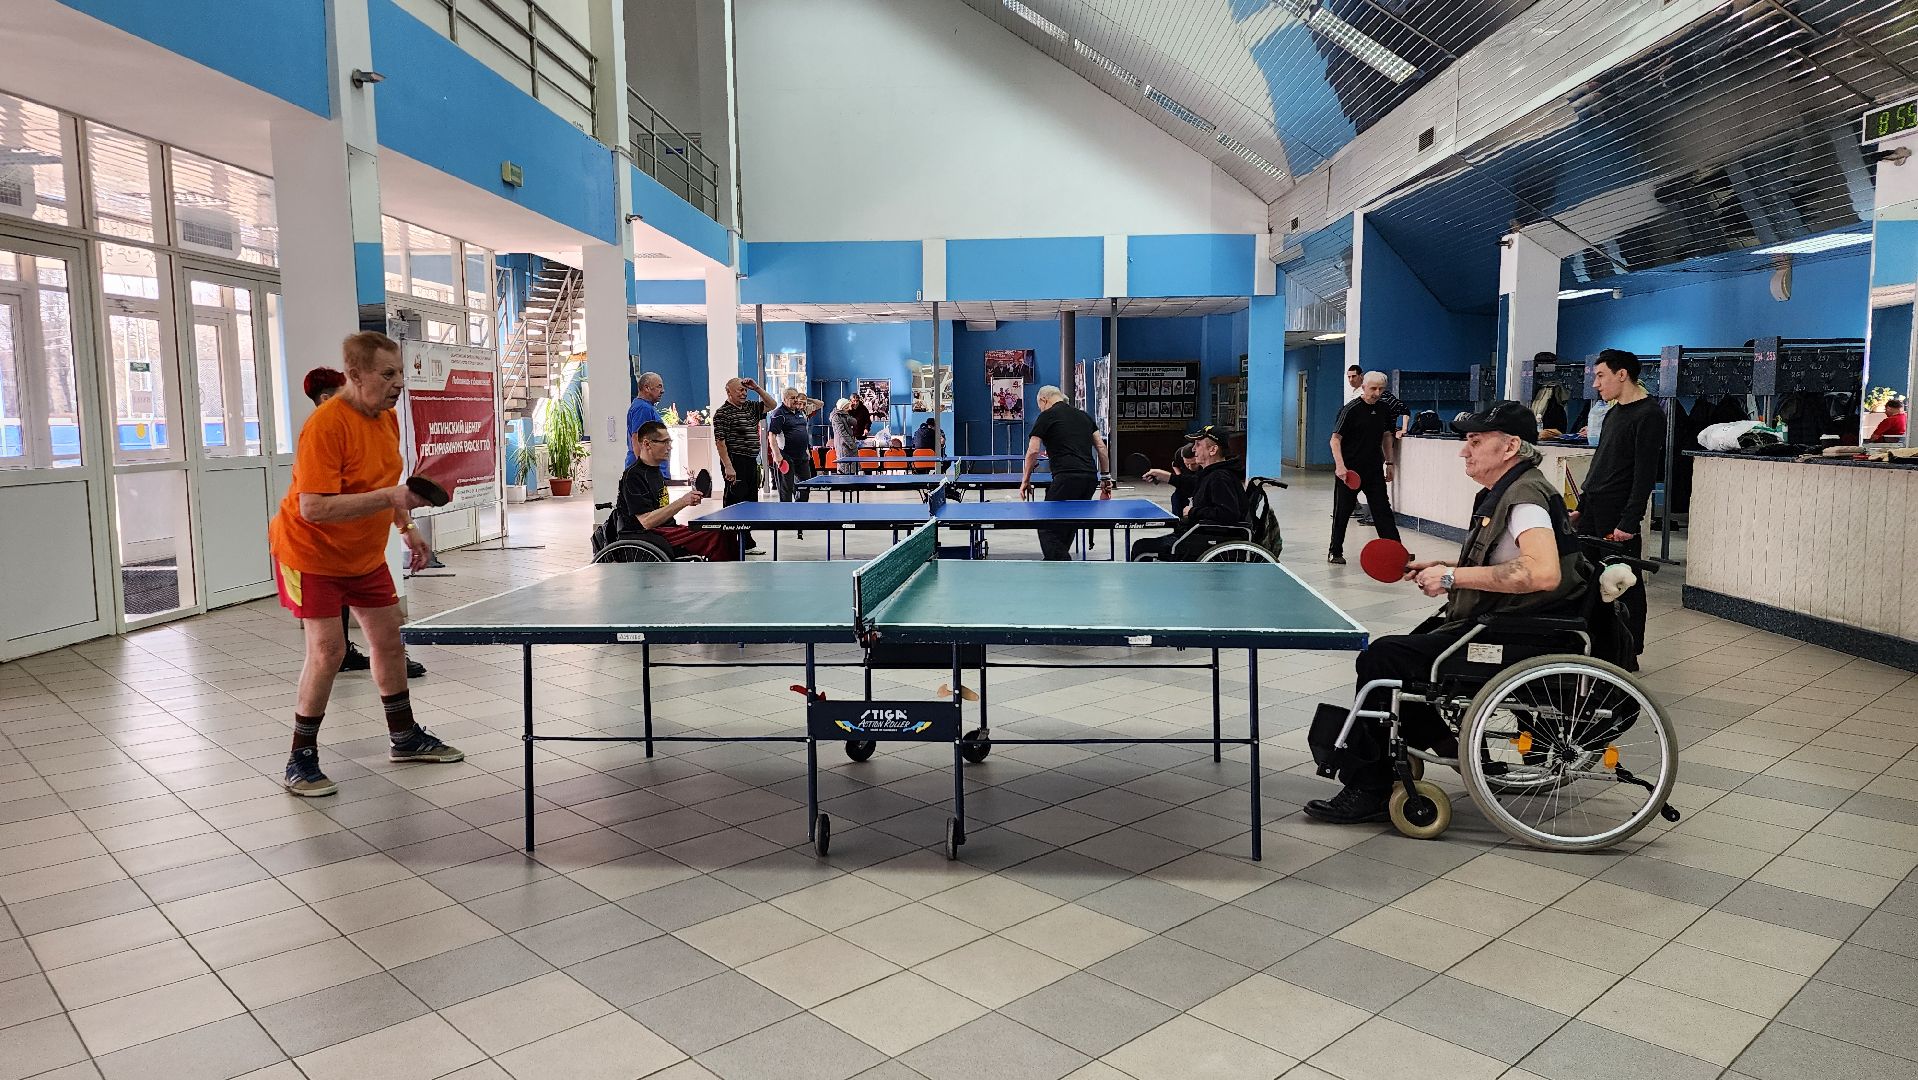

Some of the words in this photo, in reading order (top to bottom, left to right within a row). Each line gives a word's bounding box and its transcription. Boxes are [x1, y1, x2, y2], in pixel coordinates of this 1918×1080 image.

[429, 420, 464, 435] НОГИНСКИЙ
[464, 421, 482, 434] ЦЕНТР
[421, 440, 465, 457] ТЕСТИРОВАНИЯ
[463, 439, 480, 453] ВФСК
[480, 438, 491, 451] ГТО
[860, 709, 908, 720] STIGA
